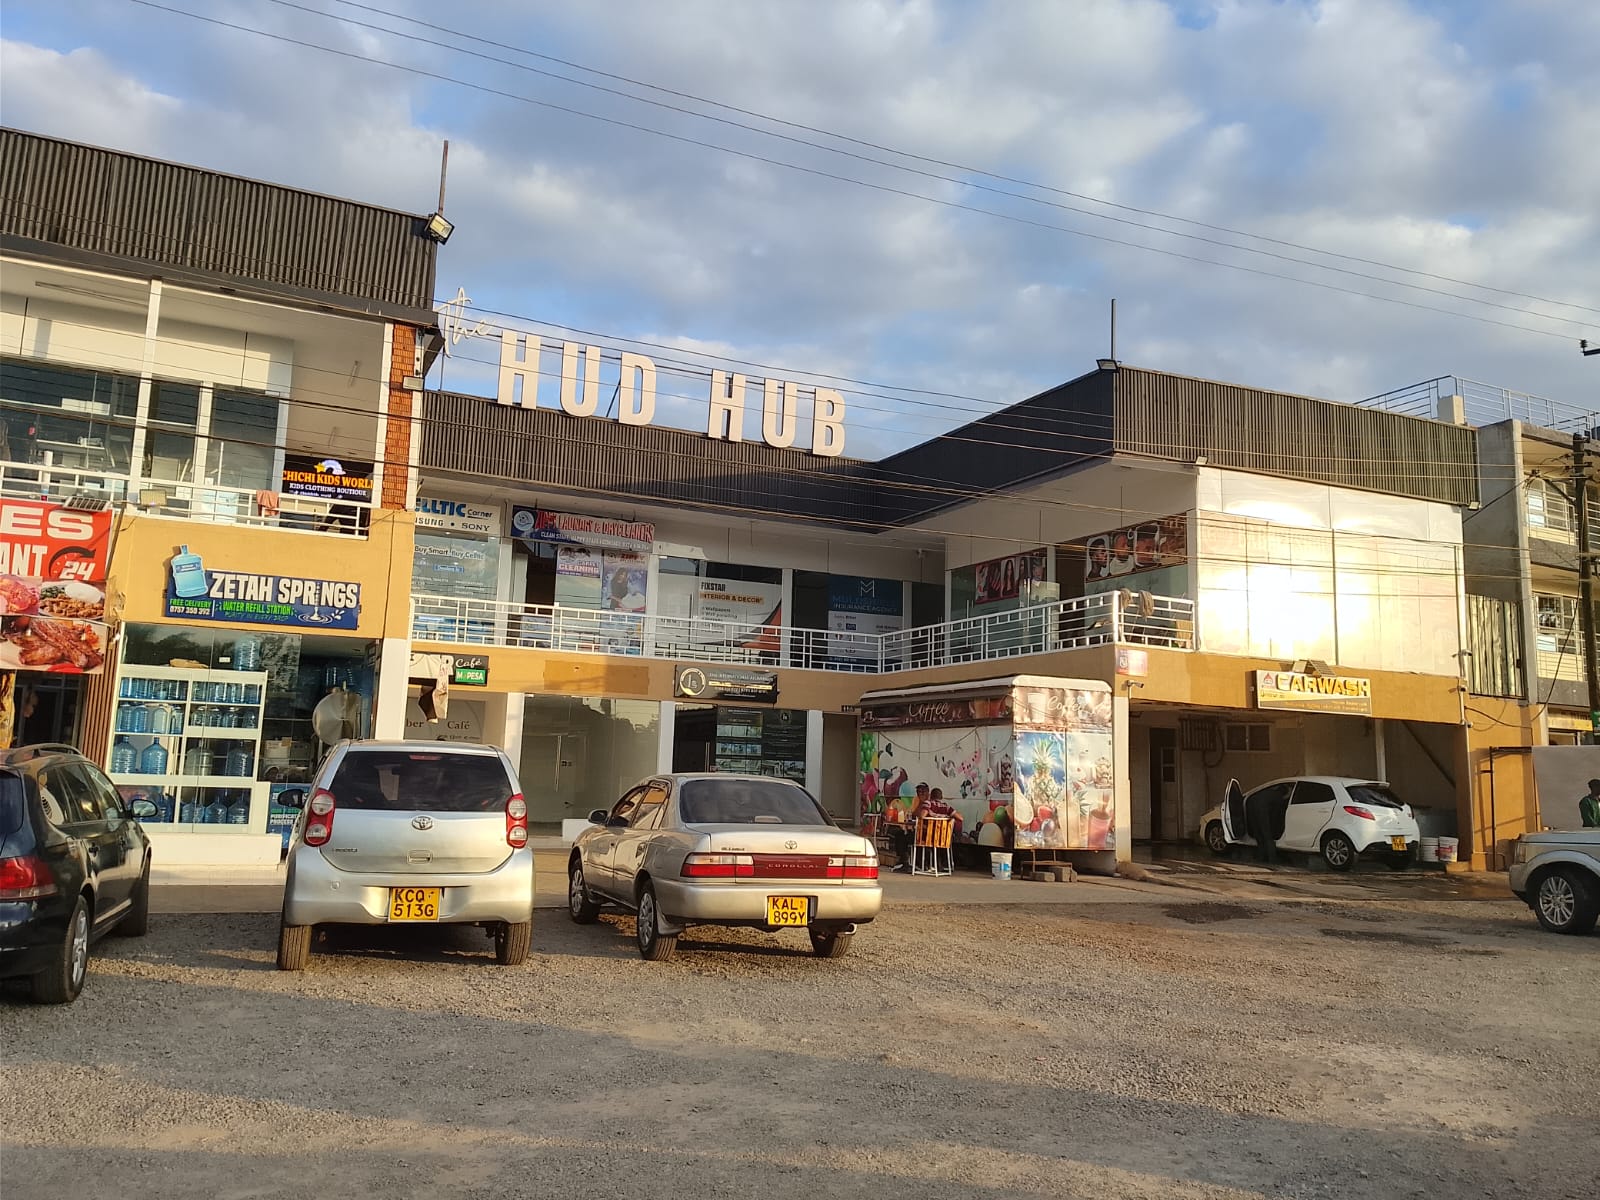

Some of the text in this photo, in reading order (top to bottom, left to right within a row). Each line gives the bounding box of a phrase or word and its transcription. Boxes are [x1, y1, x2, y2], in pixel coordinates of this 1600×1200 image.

[432, 287, 846, 457] The HUD HUB
[281, 470, 373, 489] CHICHI KIDS WORL
[305, 484, 336, 493] CLOTHING
[337, 487, 367, 496] BOUTIQUE
[467, 508, 493, 518] Corner
[0, 504, 94, 540] ES
[415, 516, 491, 532] SUNG SONY
[559, 514, 593, 533] LAUNDRY
[594, 522, 602, 534] &
[414, 545, 428, 554] Buy
[59, 561, 96, 580] 24
[558, 563, 599, 574] CLEANING
[209, 572, 358, 609] ZETAH SPRINGS
[223, 601, 291, 615] WATER REFILL STATION
[455, 657, 483, 668] Café
[1275, 673, 1369, 697] CARWASH
[447, 720, 471, 730] Café
[393, 889, 426, 903] KCQ
[393, 903, 434, 918] 513G
[771, 897, 799, 911] KAL
[773, 911, 806, 924] 899Y
